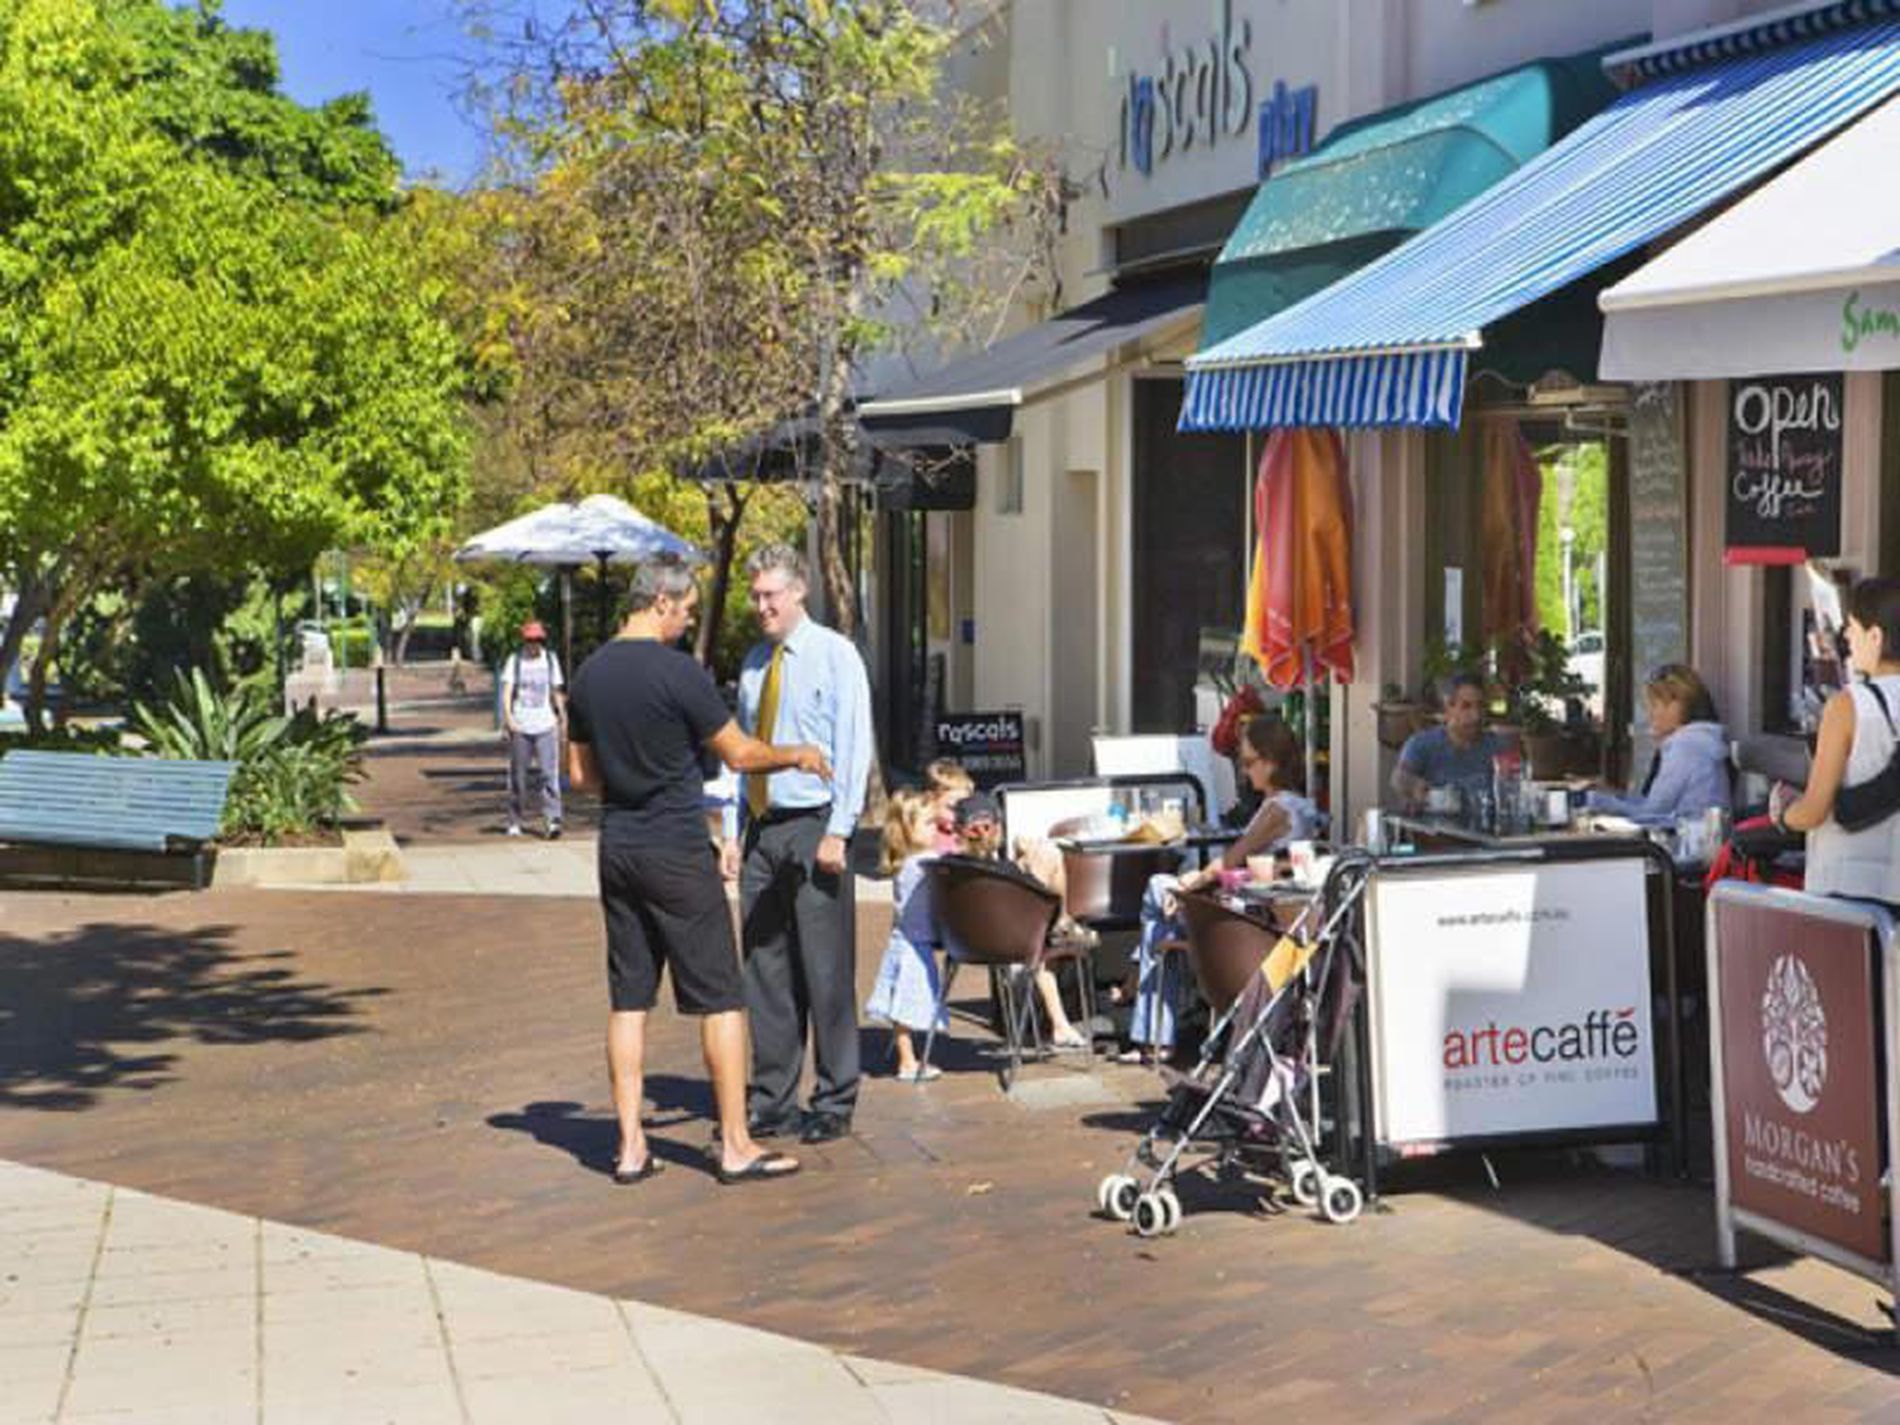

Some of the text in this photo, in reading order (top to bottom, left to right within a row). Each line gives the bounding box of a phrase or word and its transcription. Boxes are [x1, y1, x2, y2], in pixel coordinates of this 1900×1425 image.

[1734, 383, 1840, 470] Open
[1733, 471, 1824, 518] Coffee
[939, 716, 1020, 744] rascals
[1443, 1006, 1640, 1069] artecaffé
[1744, 1111, 1861, 1184] MORGAN'S
